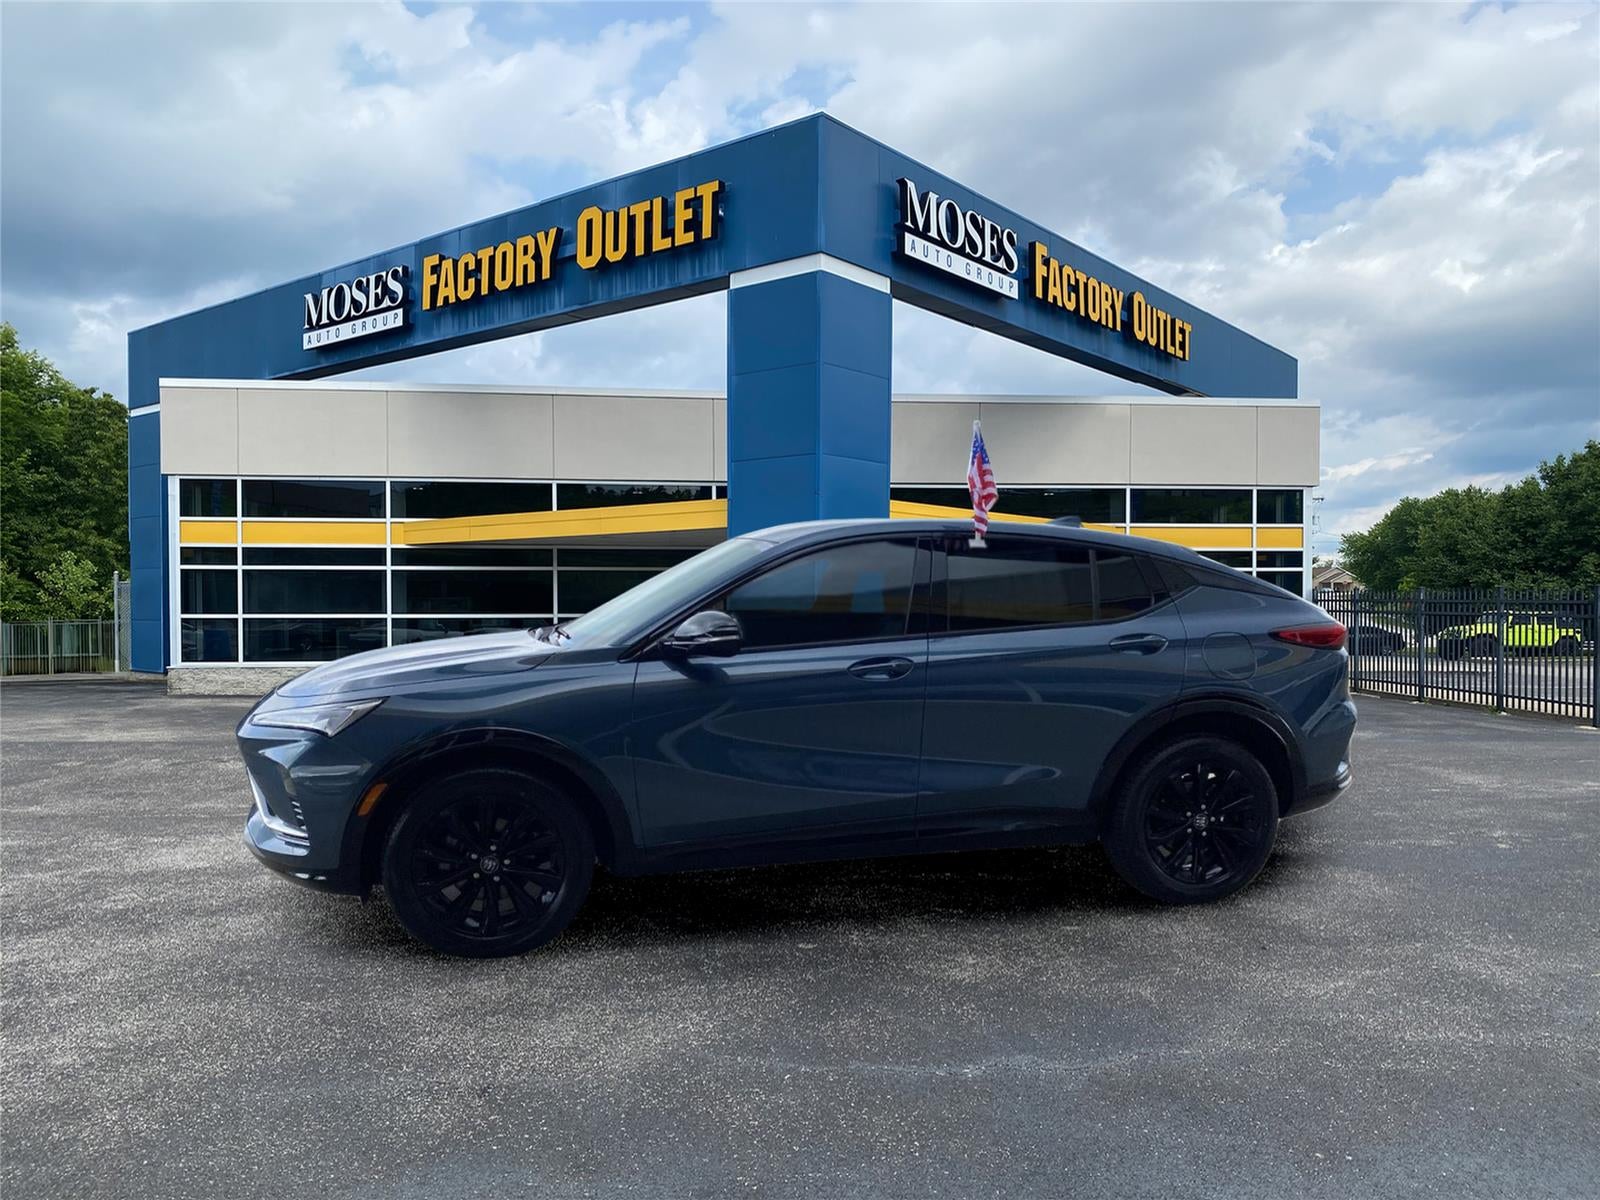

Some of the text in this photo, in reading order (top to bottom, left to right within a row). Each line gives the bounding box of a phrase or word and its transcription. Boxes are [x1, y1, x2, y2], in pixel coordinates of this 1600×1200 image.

[422, 180, 721, 311] FACTORY OUTLET
[904, 178, 1019, 274] MOSES
[303, 265, 405, 328] MOSES
[910, 239, 1015, 293] AUTO GROUP
[1034, 241, 1192, 361] FACTORY OUTLET
[307, 312, 399, 346] AUTO GROUP
